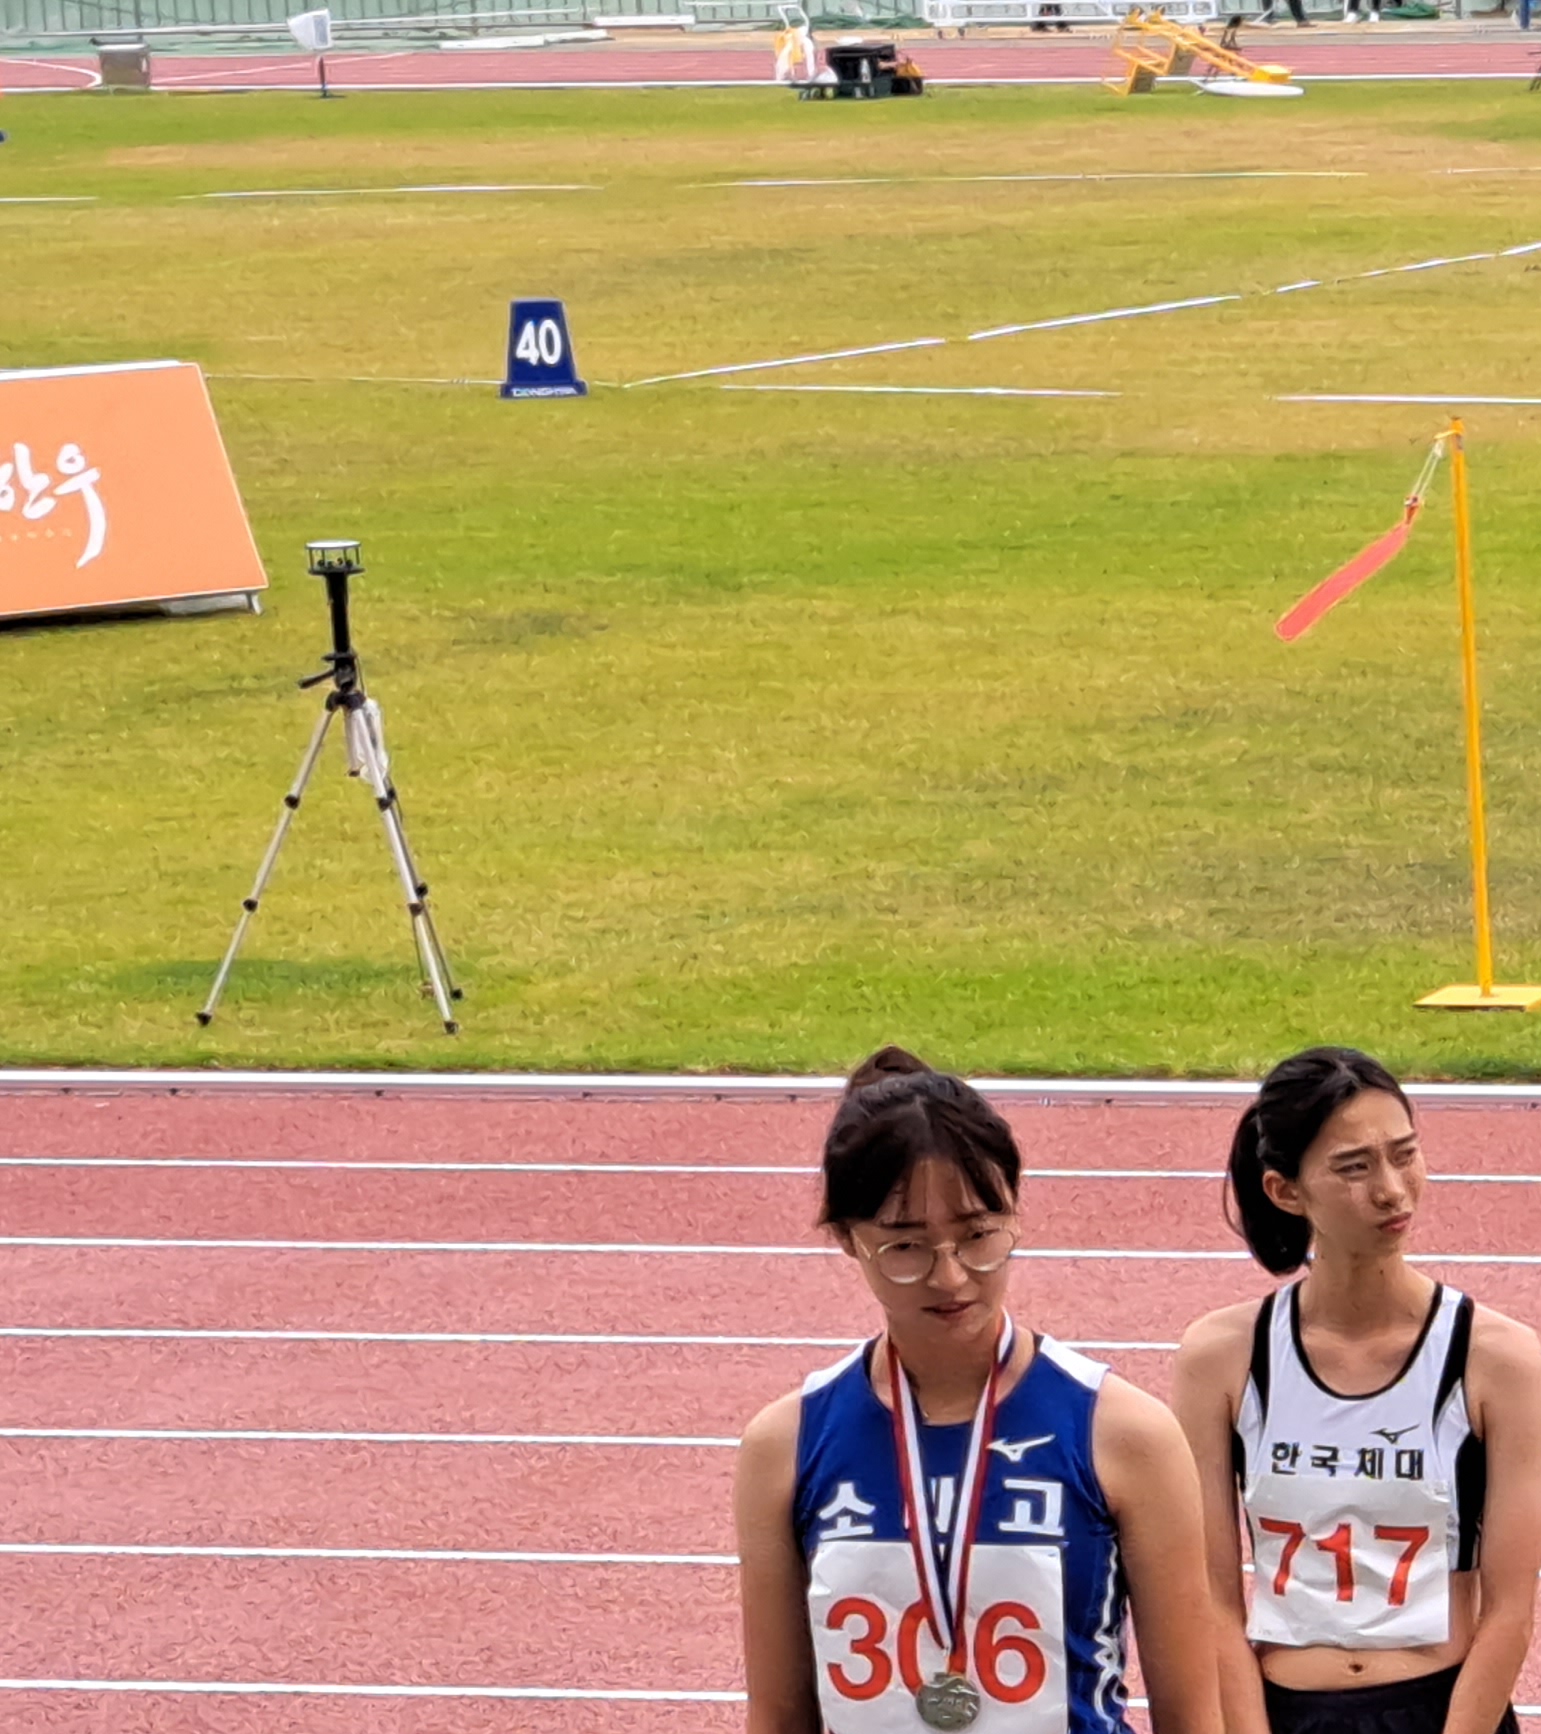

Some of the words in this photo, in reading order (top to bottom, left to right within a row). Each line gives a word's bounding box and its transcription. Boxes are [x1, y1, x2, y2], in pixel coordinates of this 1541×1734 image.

[516, 319, 562, 366] 40
[1270, 1441, 1424, 1480] 한국체대
[1259, 1517, 1430, 1606] 717
[826, 1596, 1046, 1704] 306
